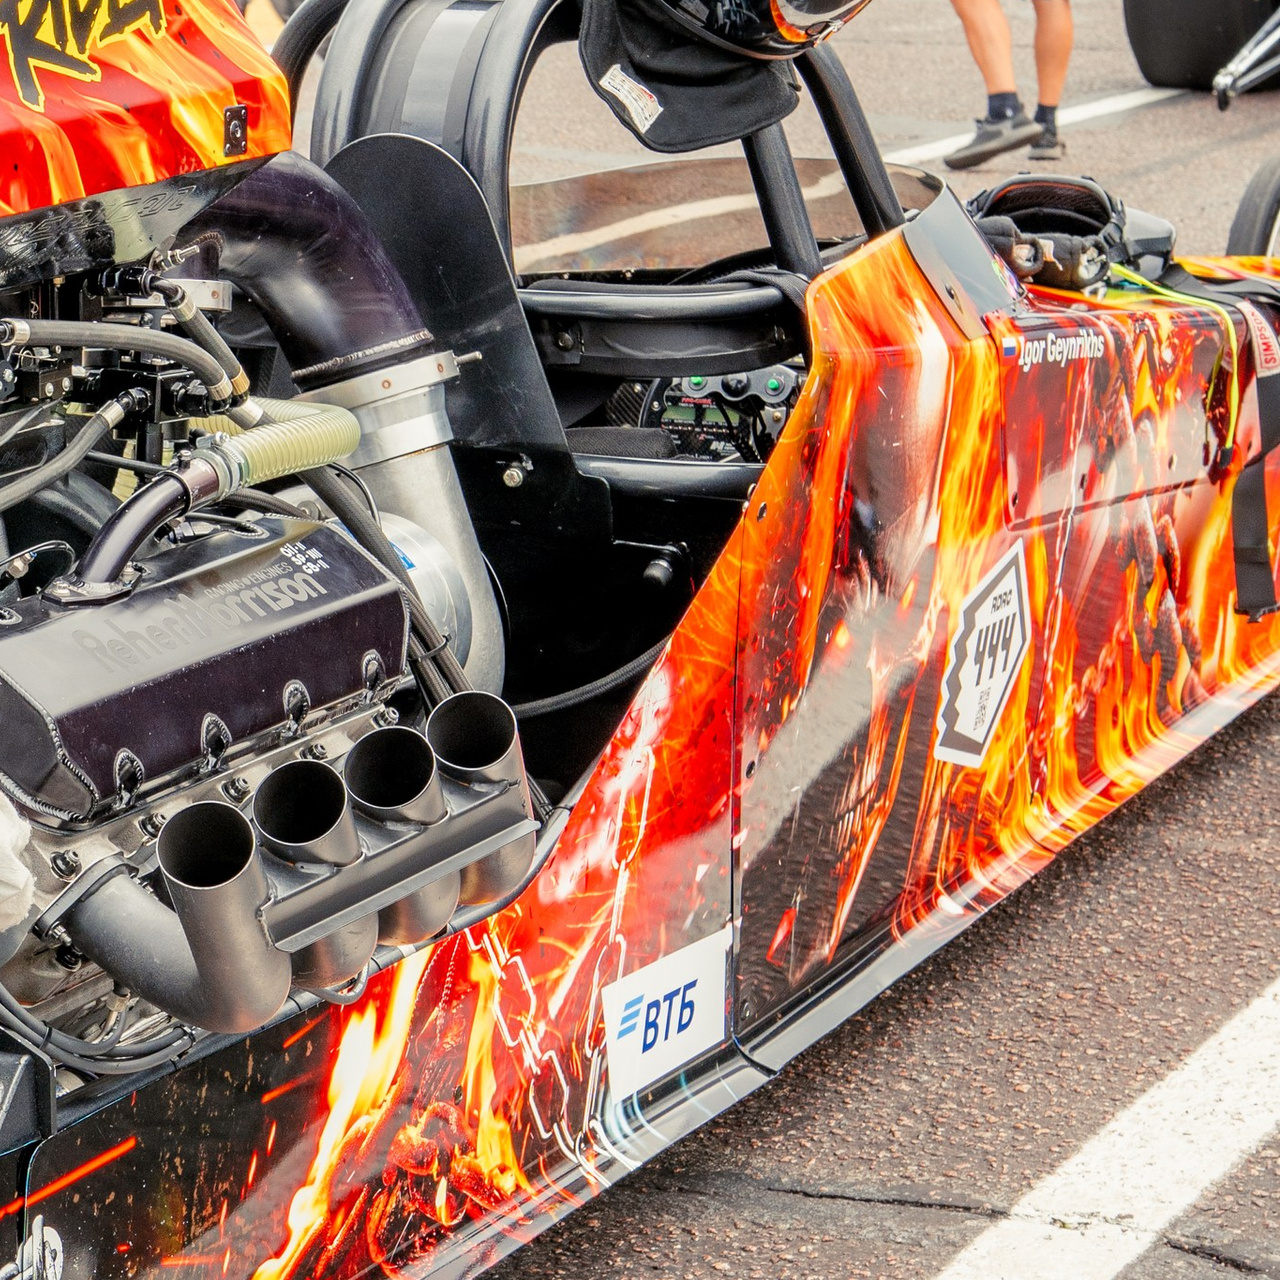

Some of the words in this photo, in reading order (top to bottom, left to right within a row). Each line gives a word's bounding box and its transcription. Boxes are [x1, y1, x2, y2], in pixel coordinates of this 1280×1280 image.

[1018, 336, 1046, 373] Igor
[1047, 328, 1105, 368] Geynrikhs
[974, 612, 1017, 687] 444
[641, 978, 699, 1054] ВТБ
